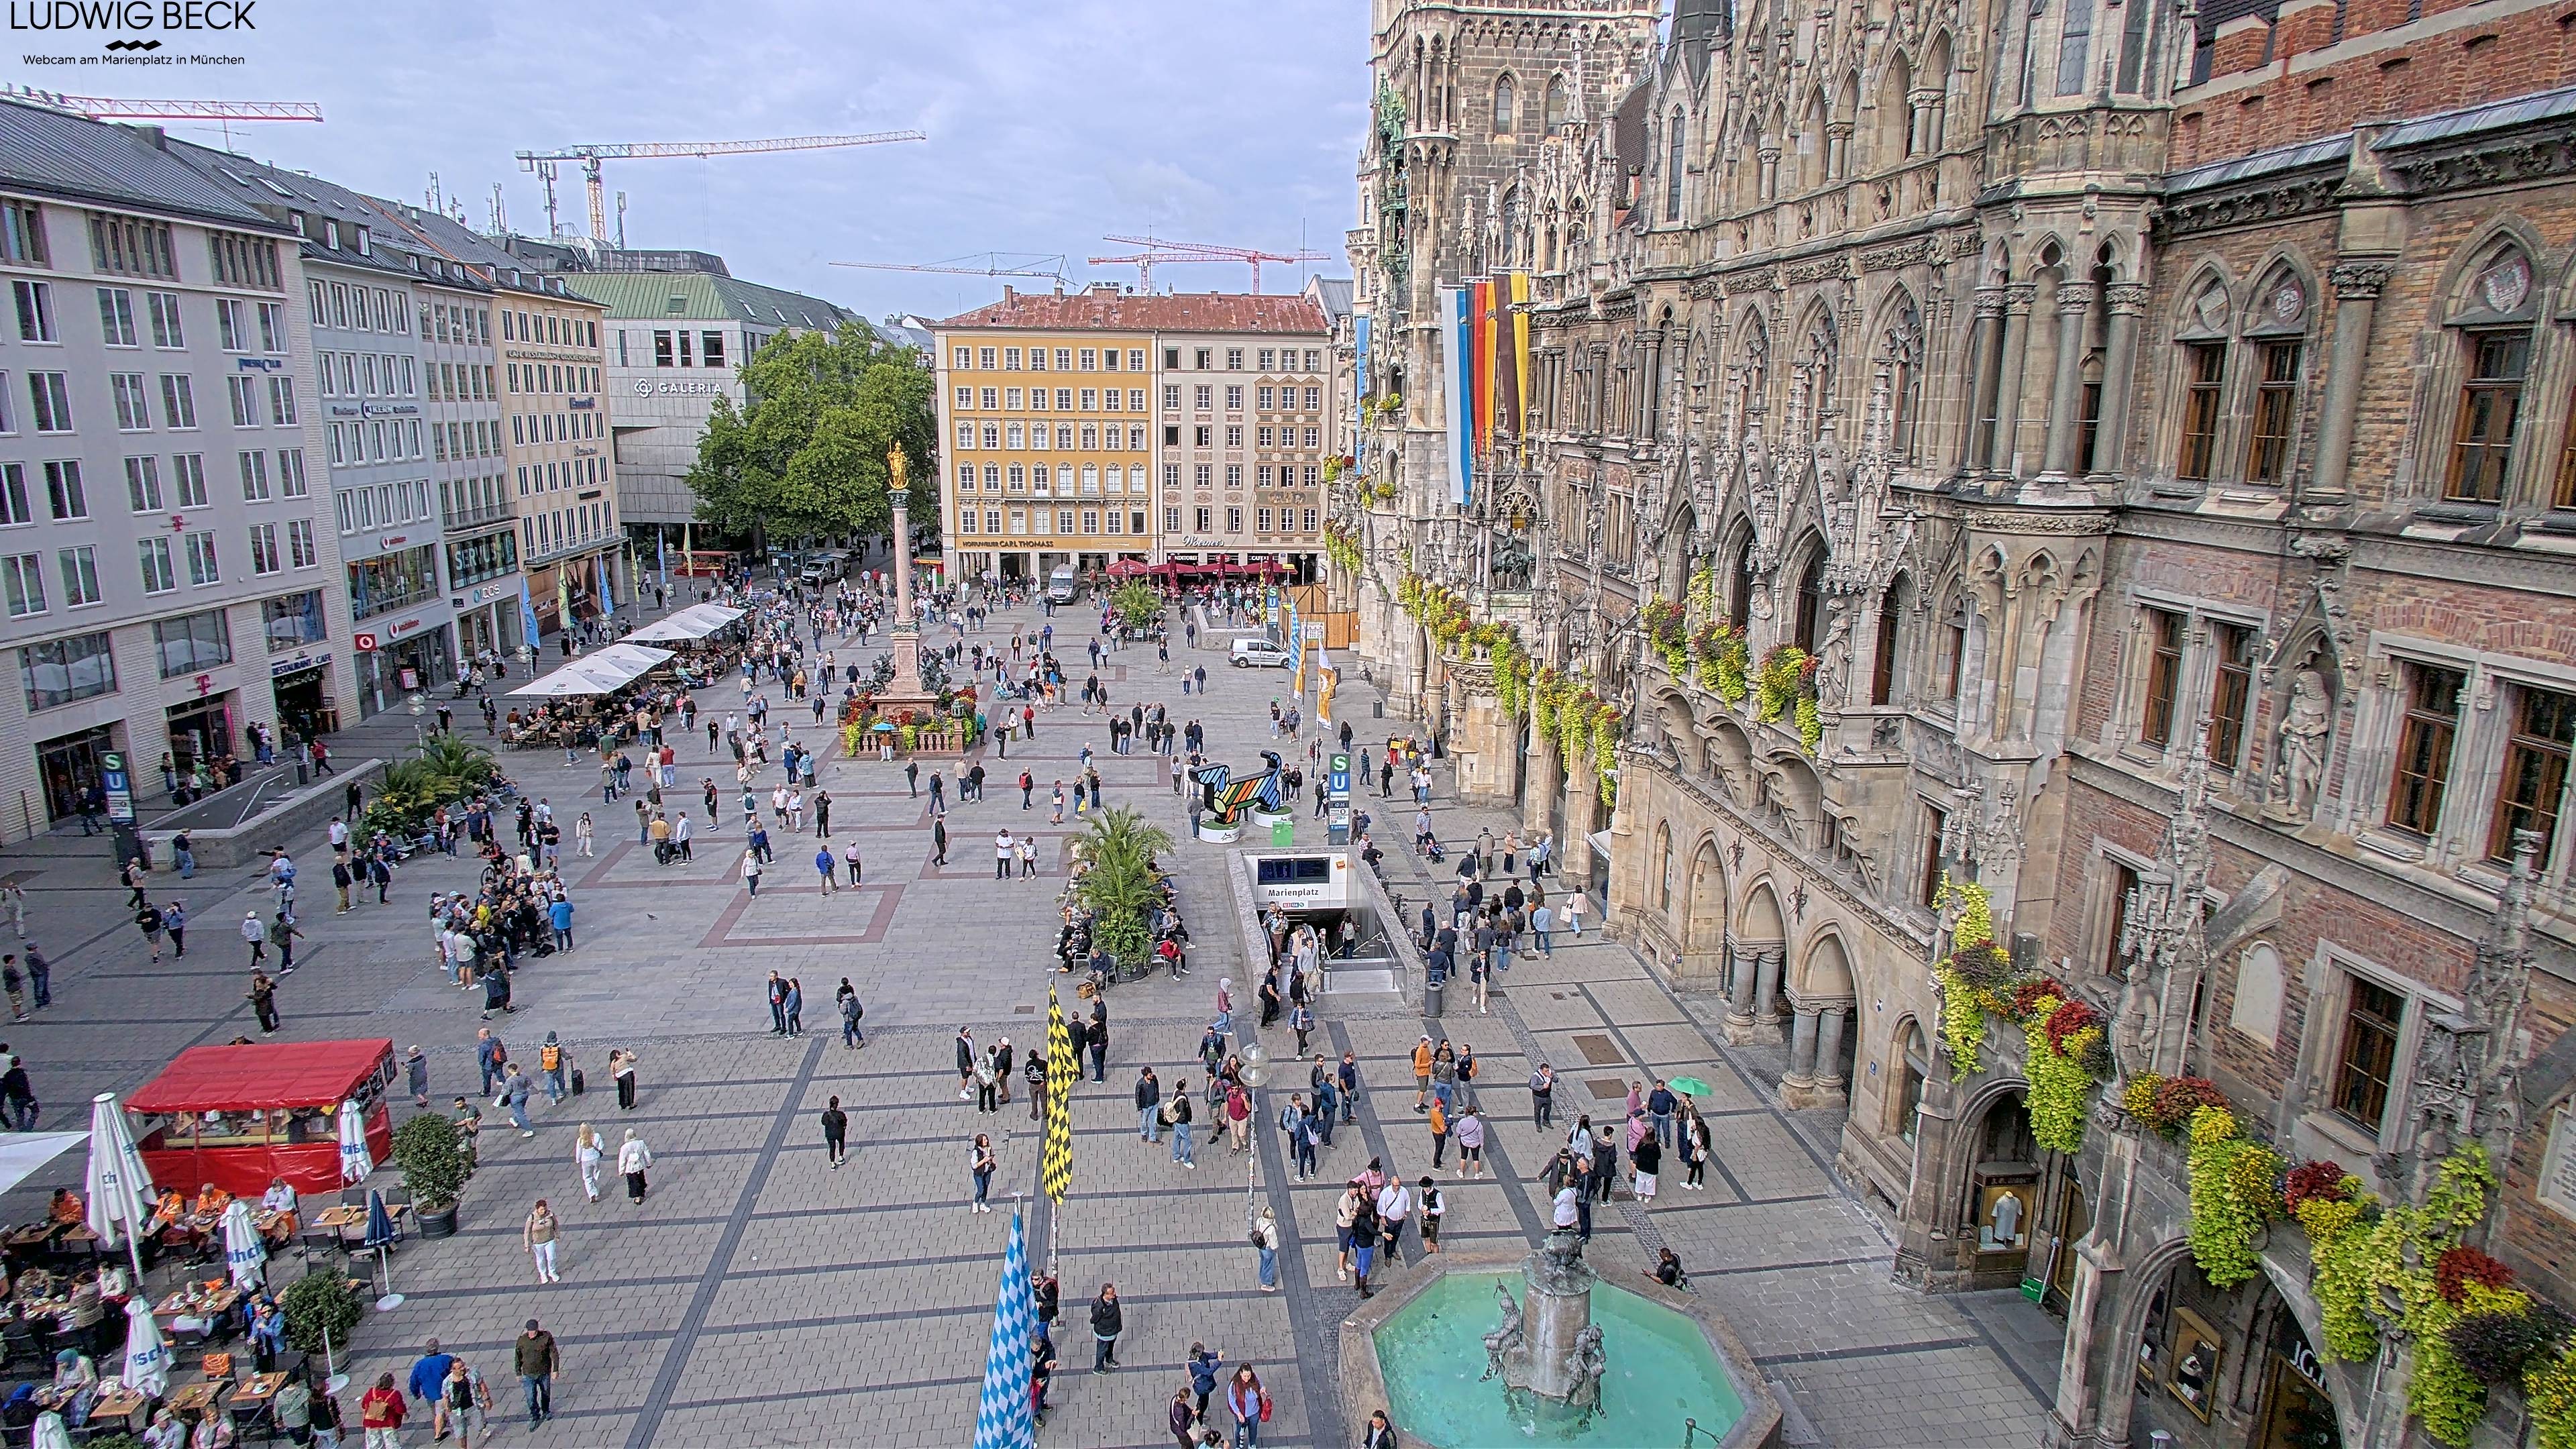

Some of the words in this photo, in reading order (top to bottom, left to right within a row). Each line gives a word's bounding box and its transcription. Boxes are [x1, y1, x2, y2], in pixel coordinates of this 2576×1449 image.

[658, 383, 723, 394] GALERIA
[105, 755, 121, 769] S
[1334, 756, 1346, 771] S
[108, 773, 122, 789] U
[1334, 775, 1346, 790] U
[1268, 888, 1319, 898] Marienplatz
